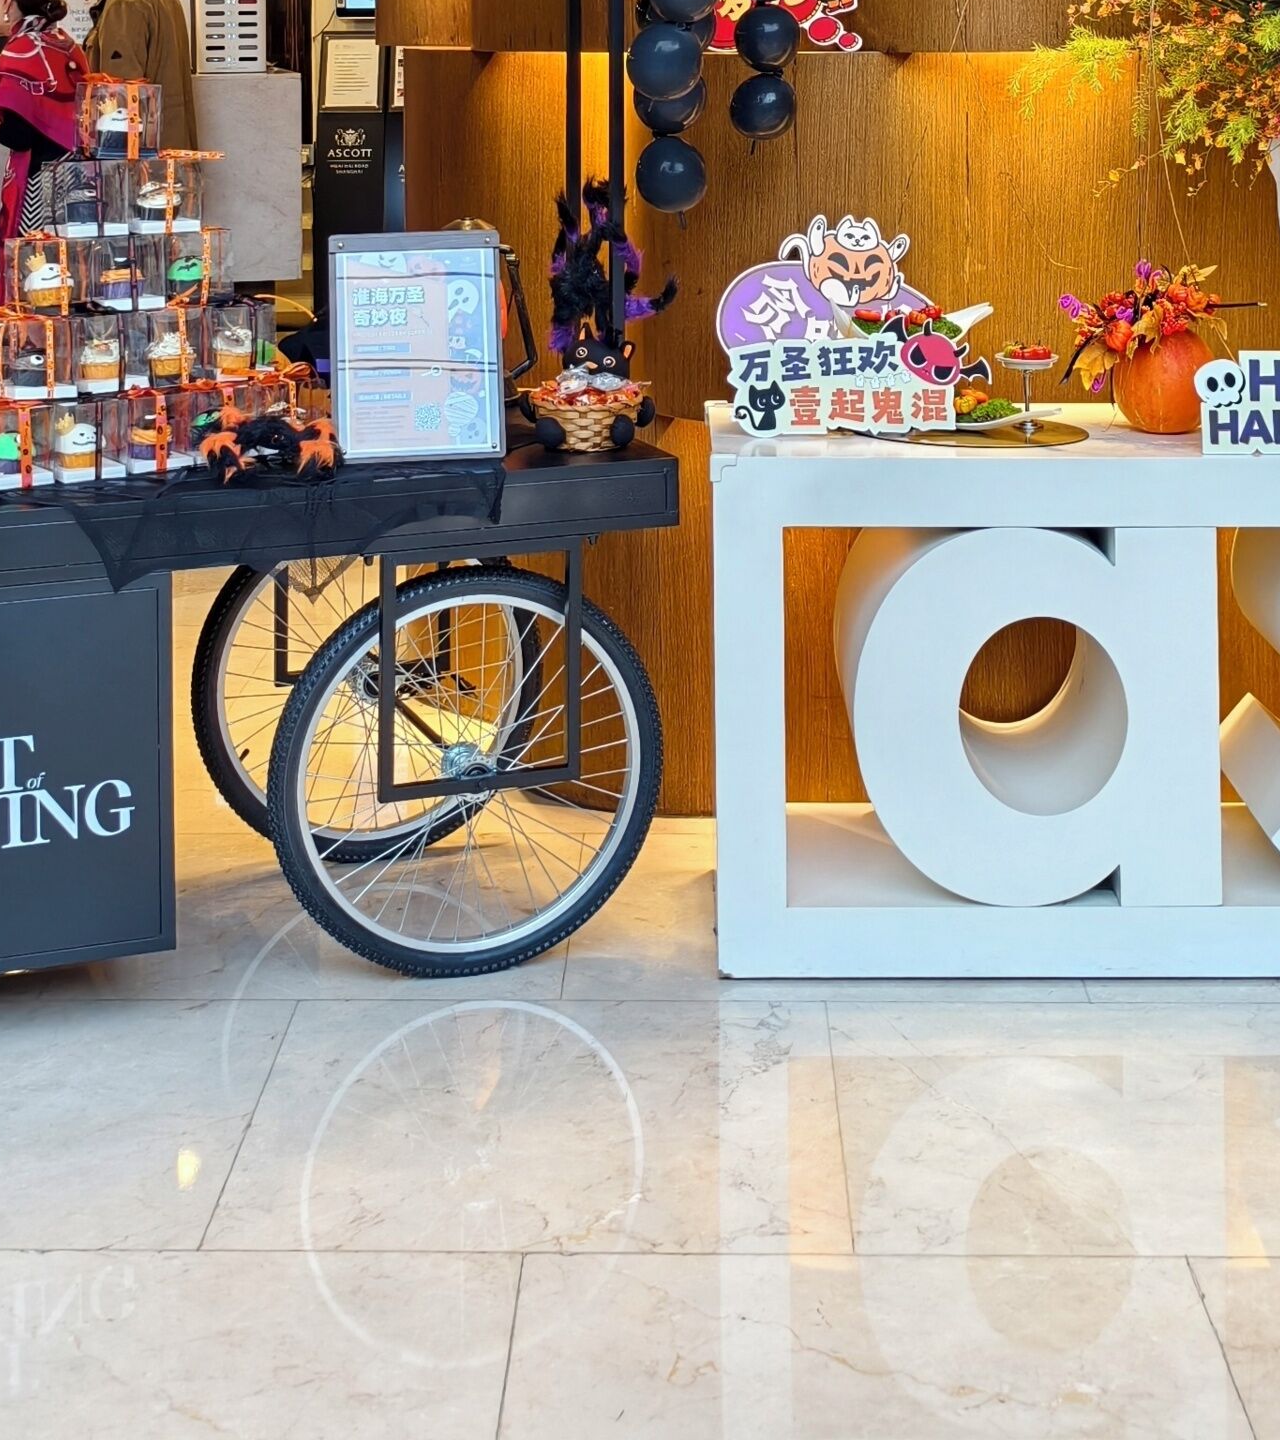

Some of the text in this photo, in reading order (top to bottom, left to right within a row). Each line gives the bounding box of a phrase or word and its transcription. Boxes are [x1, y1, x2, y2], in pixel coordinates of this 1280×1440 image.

[327, 148, 372, 157] ASCOTT
[352, 286, 425, 306] 淮海万圣
[353, 309, 408, 328] 奇妙夜
[739, 340, 900, 383] 万圣狂欢
[789, 385, 948, 427] 壹起鬼混
[26, 772, 46, 790] of
